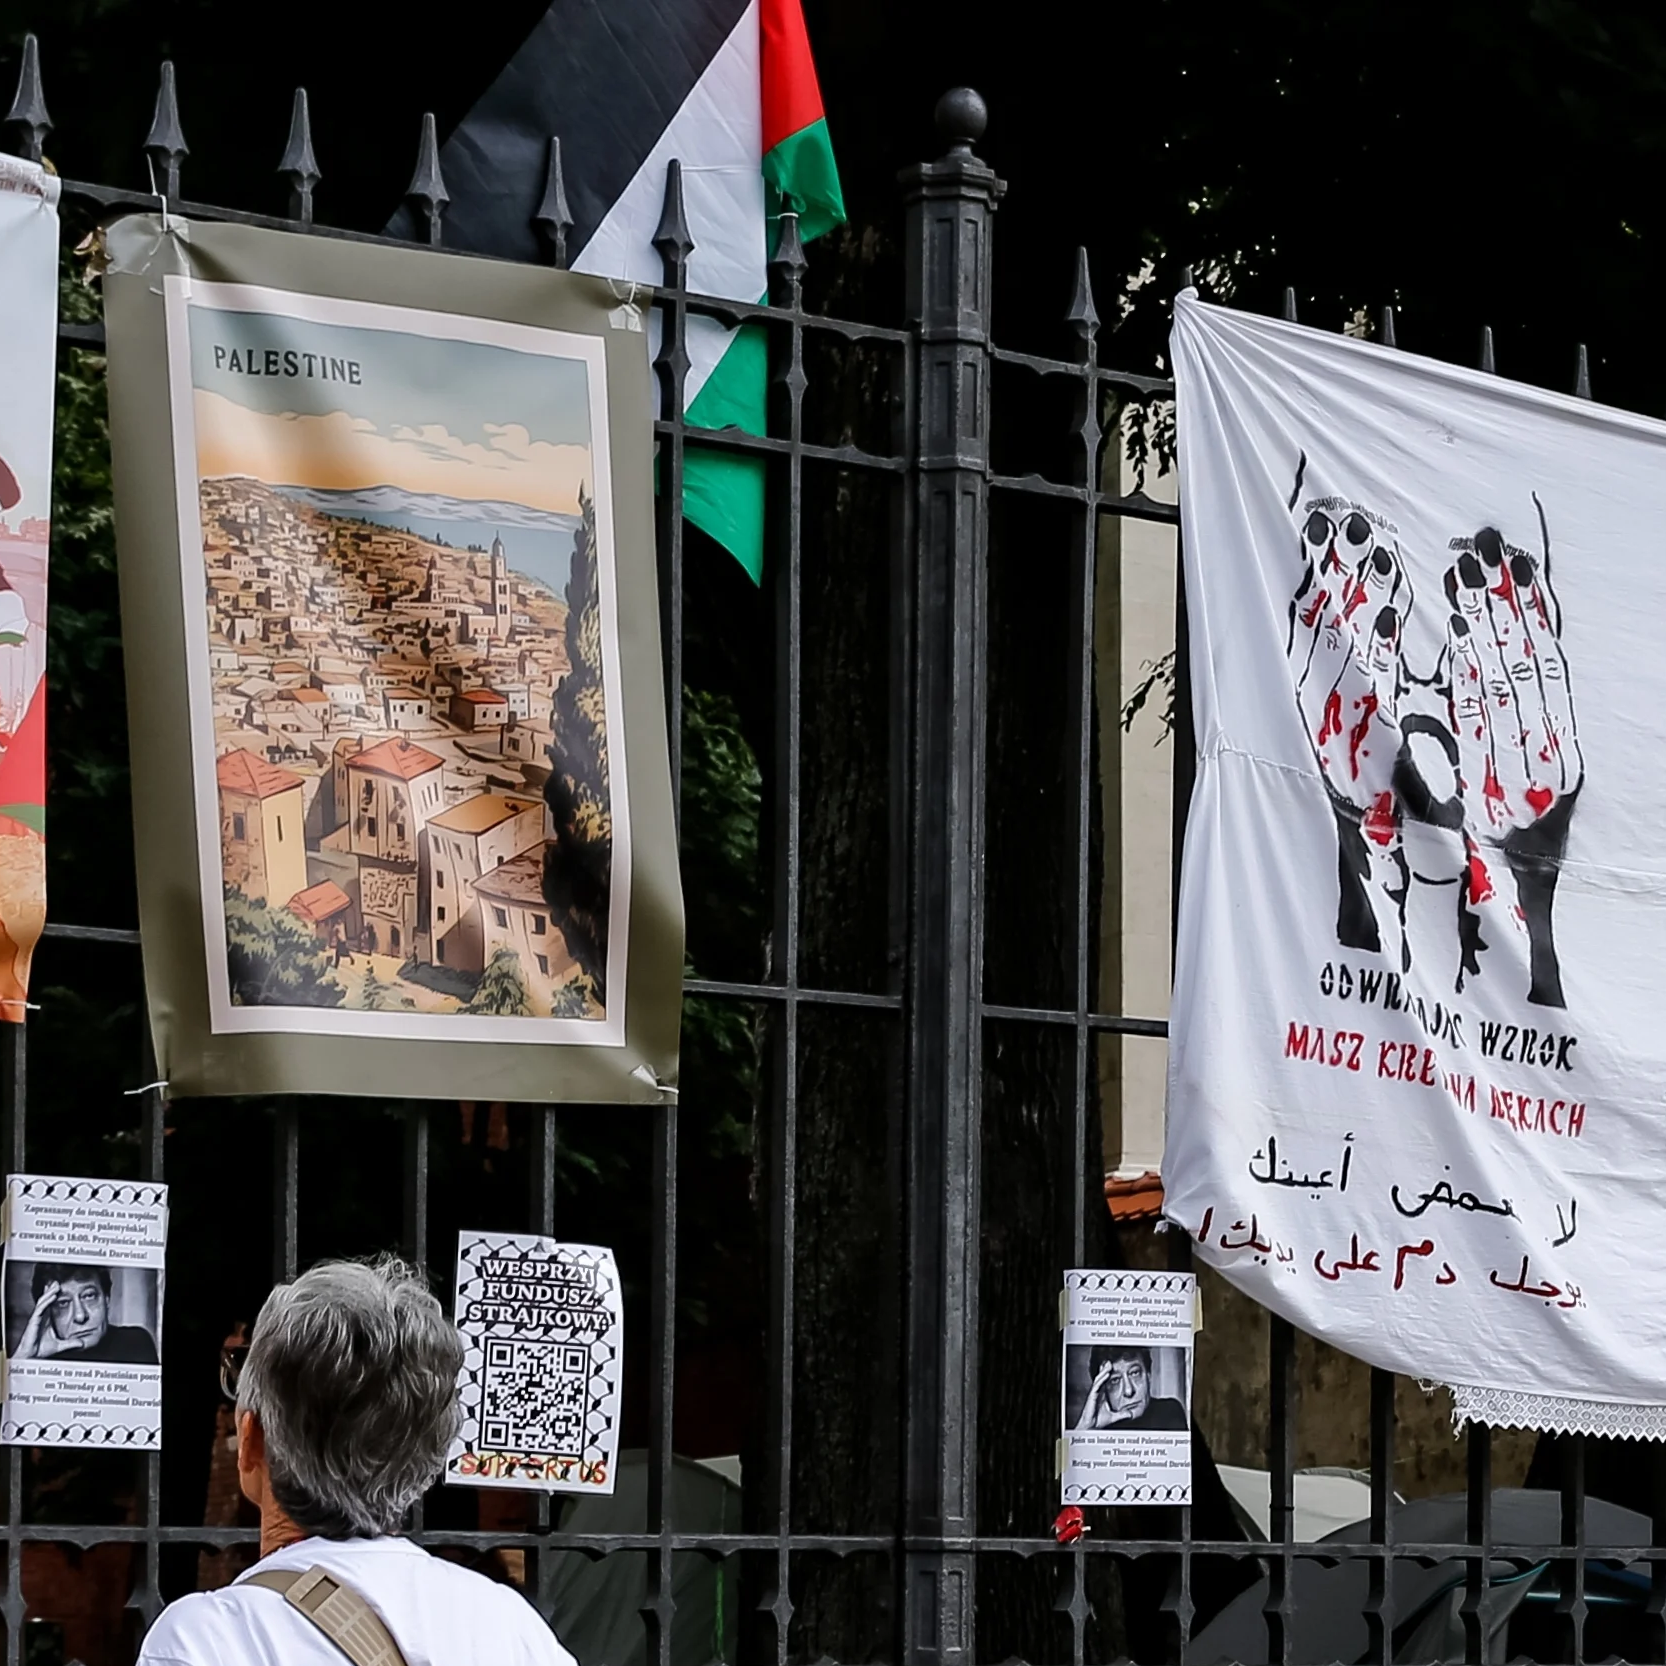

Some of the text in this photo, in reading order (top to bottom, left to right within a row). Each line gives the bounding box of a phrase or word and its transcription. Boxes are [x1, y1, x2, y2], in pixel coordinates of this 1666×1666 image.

[213, 344, 363, 387] PALESTINE
[1479, 1020, 1578, 1072] WZROK
[1284, 1020, 1365, 1071] MASZ
[1449, 1072, 1477, 1113] NA
[1488, 1083, 1586, 1138] RĘKACH
[483, 1258, 597, 1288] WESPRZYJ
[485, 1283, 596, 1306] FUNDUSZ
[467, 1303, 610, 1331] STRAJKOWY:
[57, 1381, 96, 1393] Thursday
[75, 1369, 93, 1378] read
[94, 1370, 138, 1381] Palestinian
[139, 1372, 161, 1383] poetr
